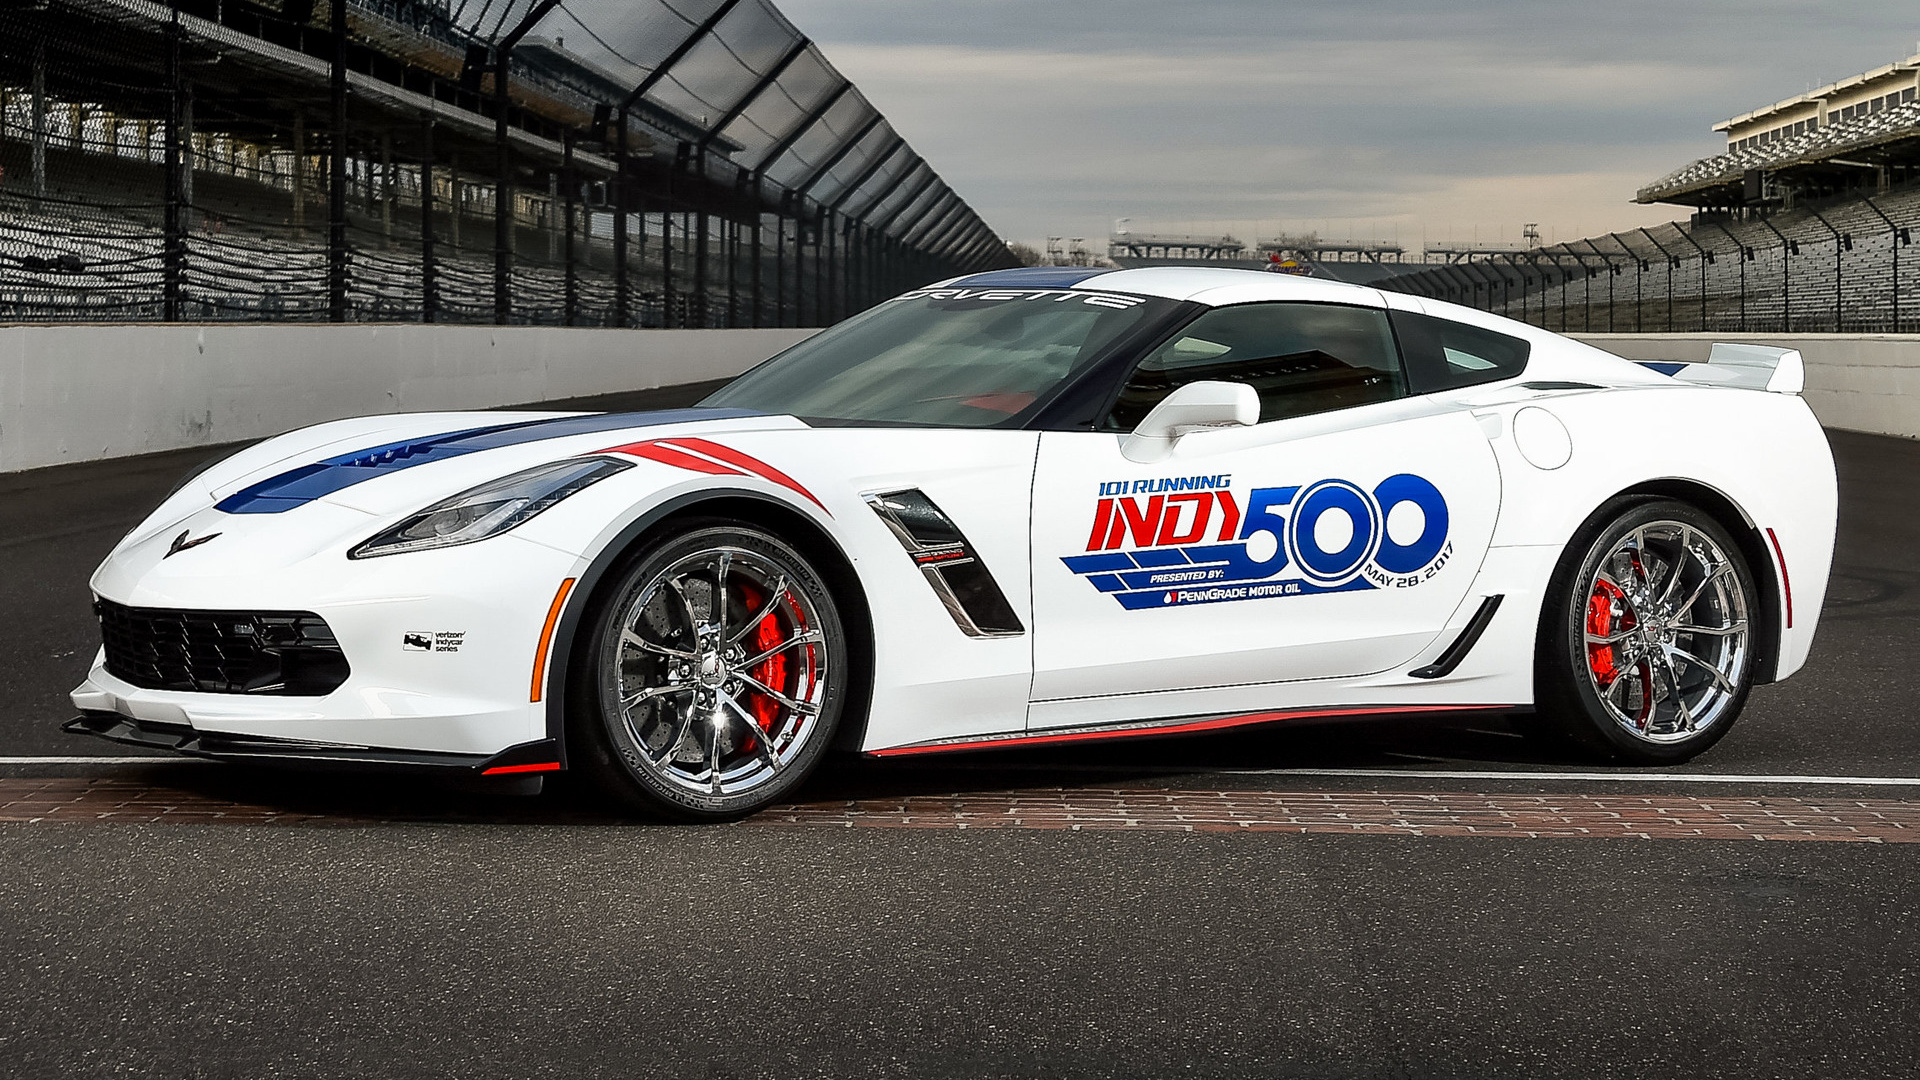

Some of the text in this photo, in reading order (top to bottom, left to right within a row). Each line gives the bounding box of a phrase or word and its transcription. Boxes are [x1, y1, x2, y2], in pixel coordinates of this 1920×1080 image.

[1099, 474, 1231, 496] 101 RUNNING
[1086, 473, 1449, 582] INDY 500
[1364, 563, 1394, 587] MAY
[1424, 540, 1453, 580] 2017
[1150, 569, 1224, 583] PRESENTED BY:
[1249, 585, 1282, 597] MOTOR
[1284, 583, 1301, 594] OIL
